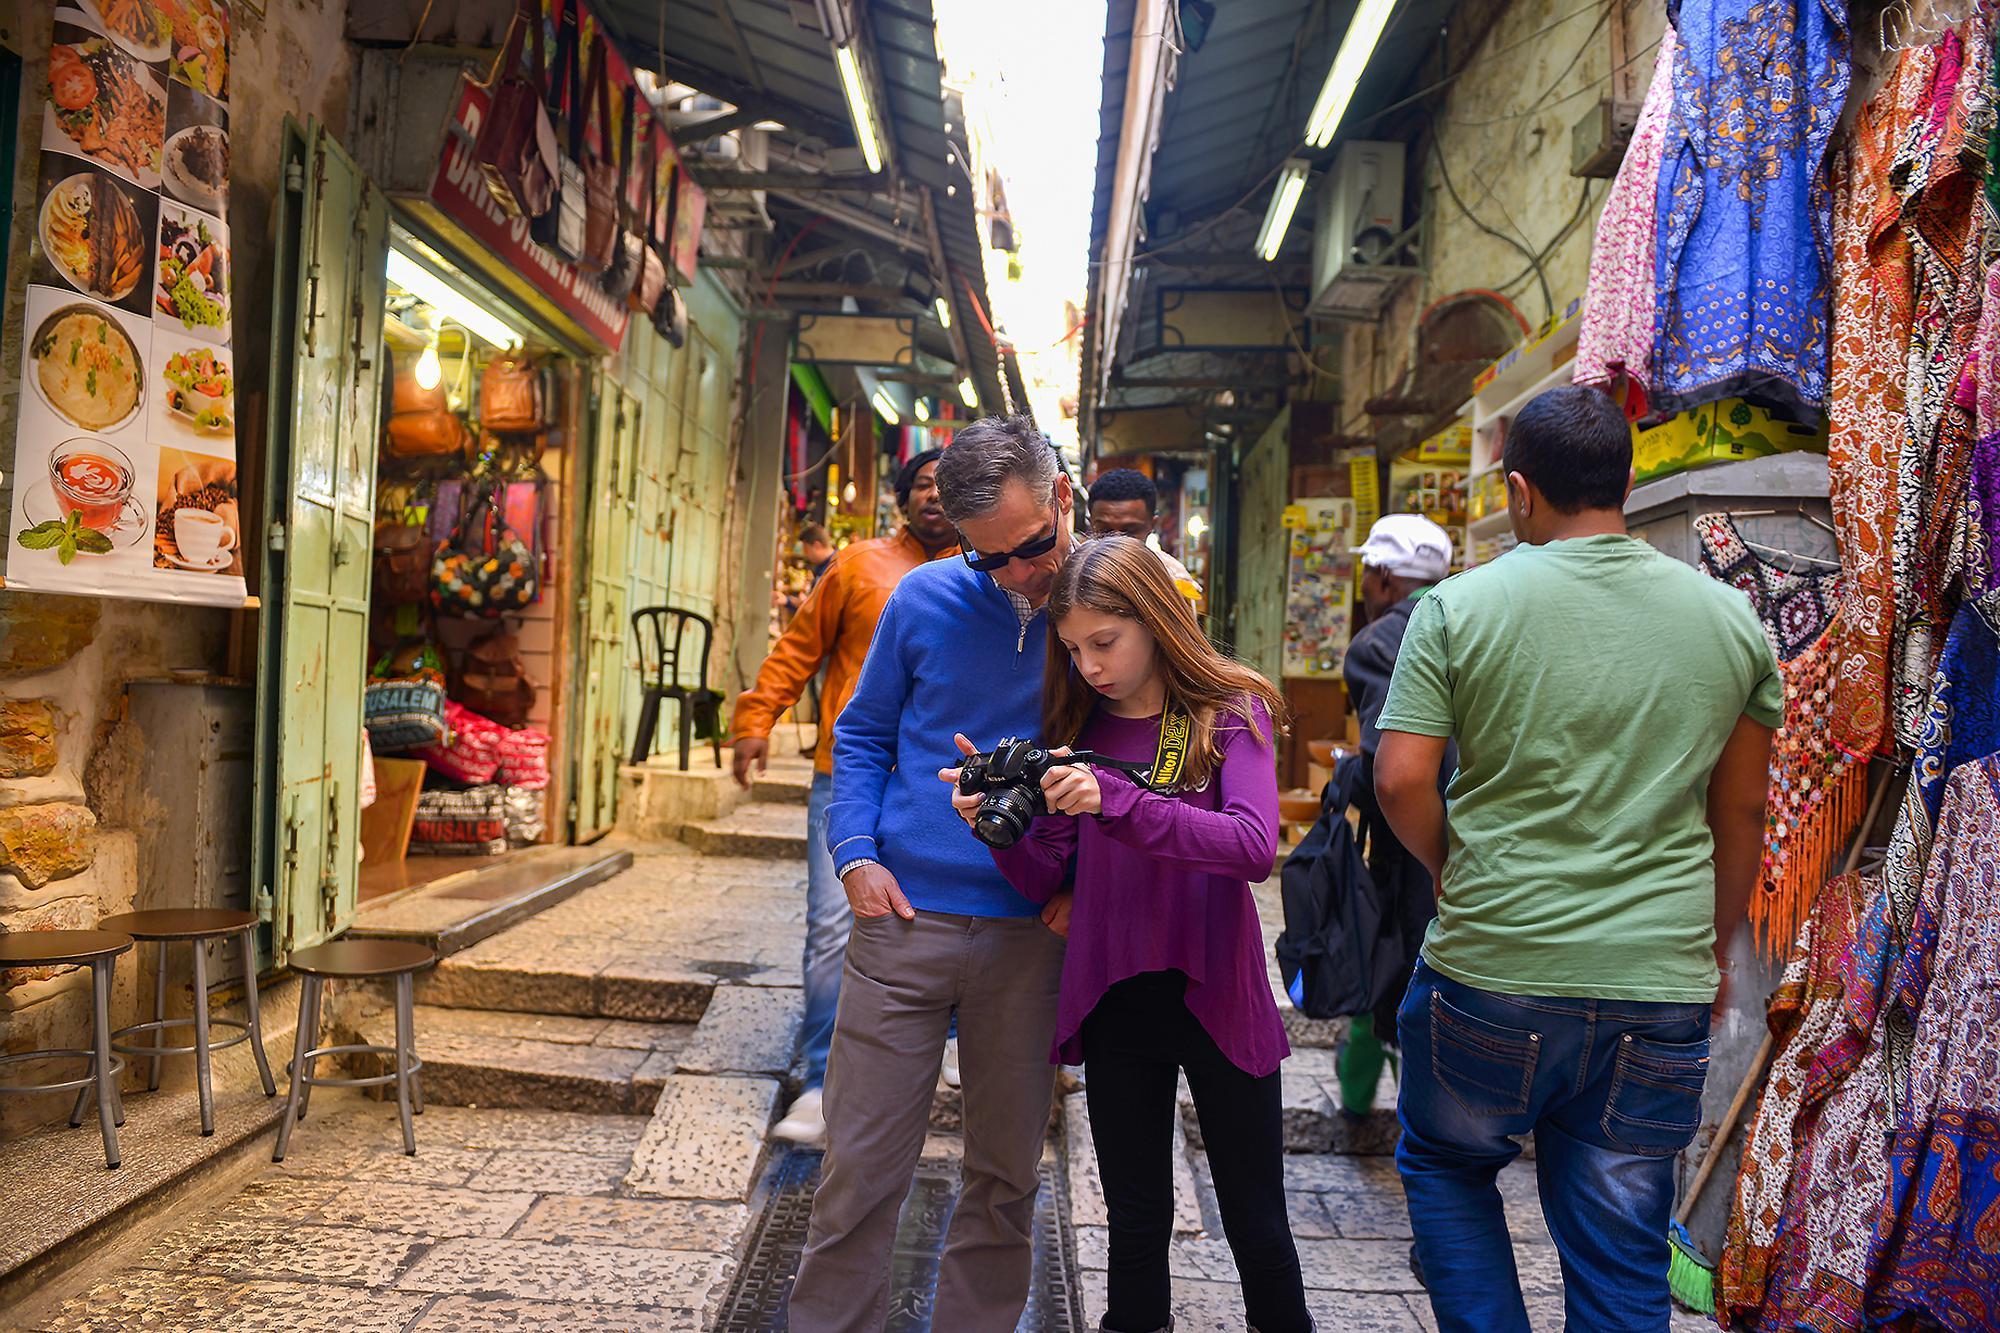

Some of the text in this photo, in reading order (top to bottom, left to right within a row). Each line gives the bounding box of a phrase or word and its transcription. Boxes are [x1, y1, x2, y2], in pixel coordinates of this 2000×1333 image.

[365, 688, 437, 712] USALEM
[1155, 751, 1178, 784] Nikon
[414, 819, 503, 843] RUSALEM
